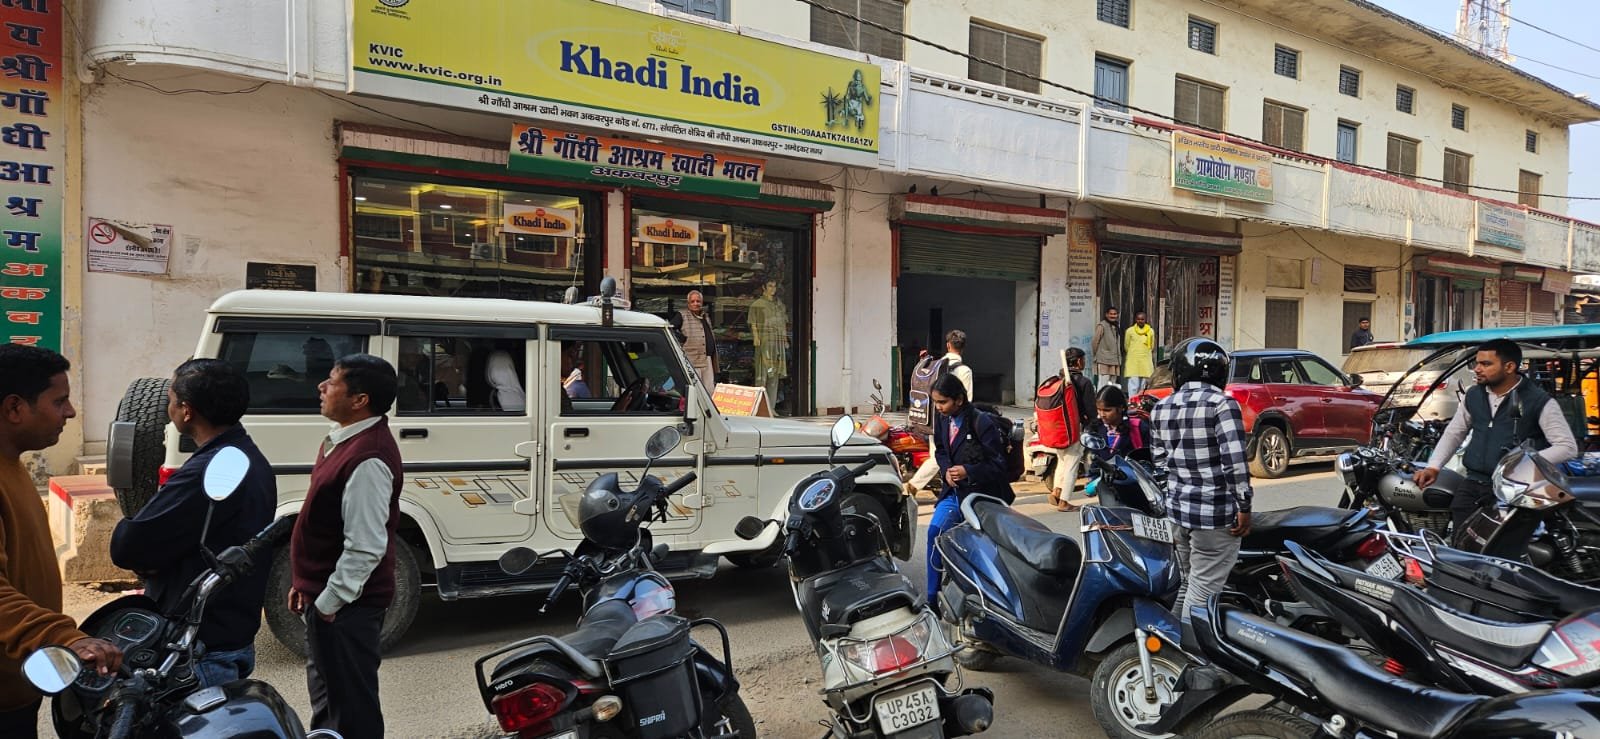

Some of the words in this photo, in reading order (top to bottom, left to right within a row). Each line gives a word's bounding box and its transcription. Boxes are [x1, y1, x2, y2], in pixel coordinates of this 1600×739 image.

[369, 43, 403, 58] KVIC
[0, 54, 51, 82] श्री
[368, 57, 502, 86] www.kvic.org.in
[559, 40, 668, 90] Khadi
[680, 64, 761, 107] India
[478, 94, 489, 104] श्री
[512, 101, 537, 113] आश्रम
[539, 105, 559, 116] खादी
[560, 109, 579, 119] भवन
[580, 112, 614, 126] अकबरपुर
[614, 116, 630, 127] कोड
[706, 129, 715, 139] श्री
[732, 135, 751, 145] आश्रम
[517, 127, 546, 155] श्री
[608, 145, 666, 170] आश्रम
[671, 152, 718, 178] खादी
[722, 160, 761, 182] भवन
[590, 167, 682, 187] अकबरपुर
[1233, 165, 1256, 185] भण्डार
[513, 215, 541, 228] Khadi
[544, 218, 567, 230] India
[646, 226, 671, 238] Khadi
[672, 228, 692, 239] India
[1198, 259, 1215, 277] श्री
[887, 689, 932, 715] UP45A
[639, 710, 666, 727] SHIPRA
[891, 707, 934, 729] C3032
